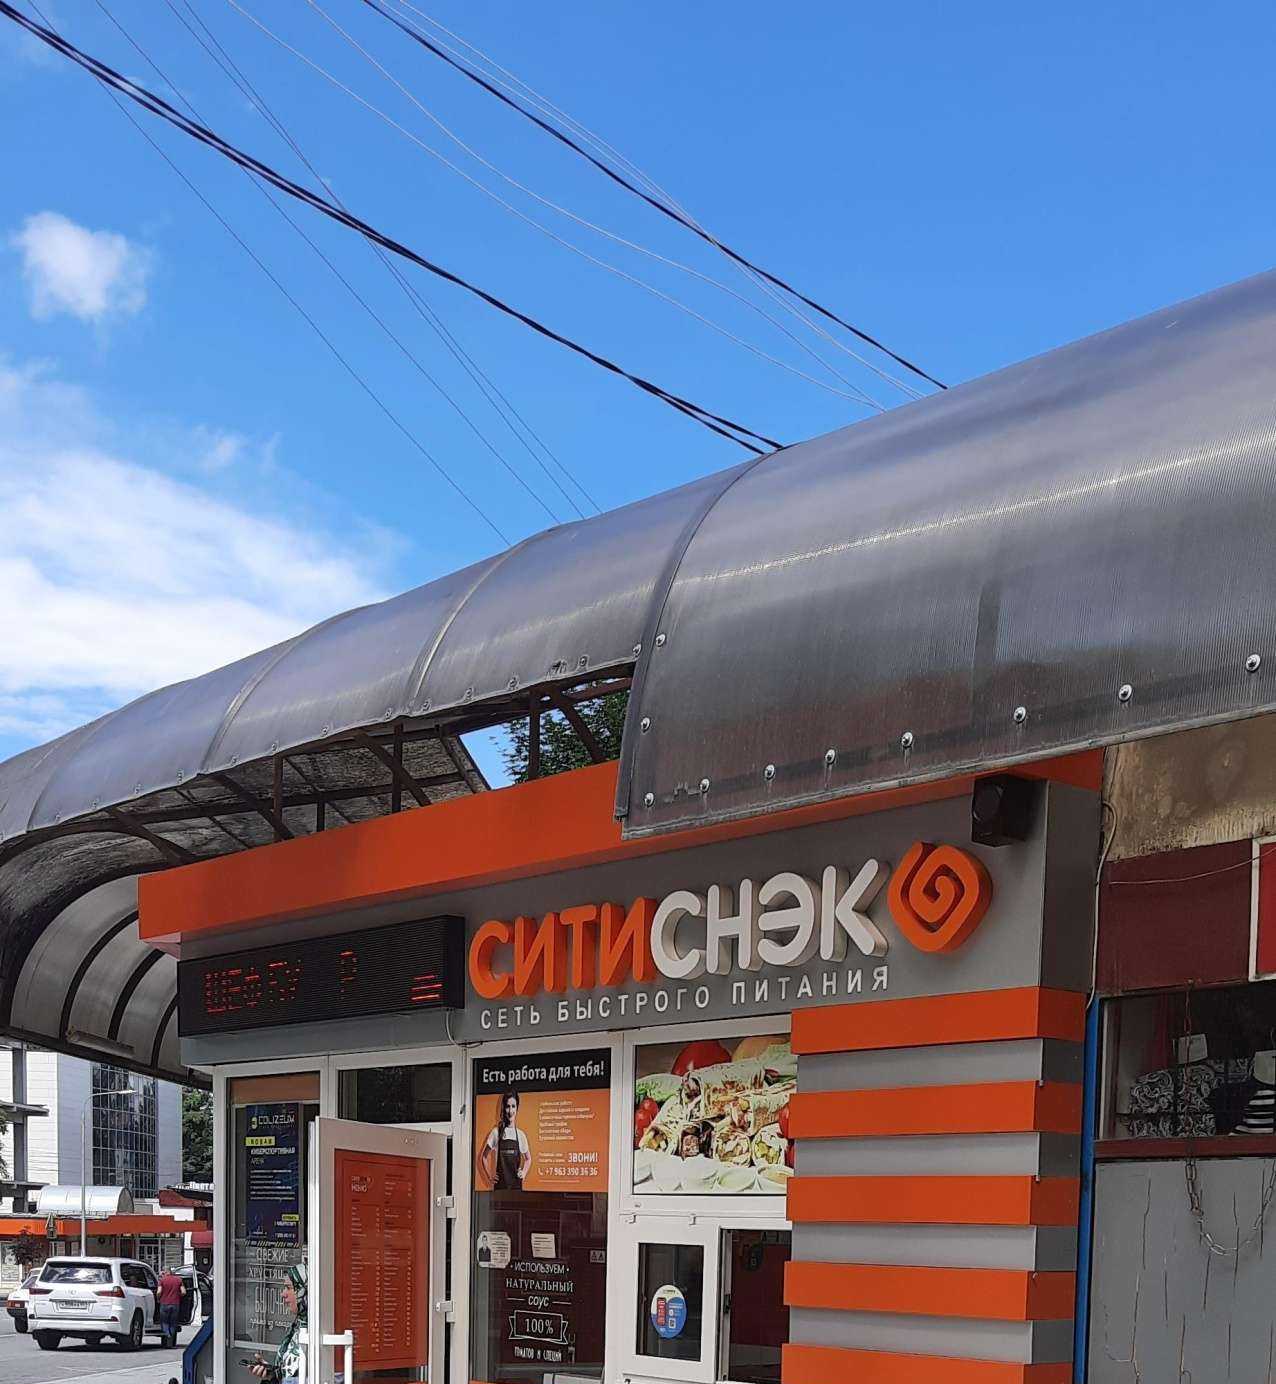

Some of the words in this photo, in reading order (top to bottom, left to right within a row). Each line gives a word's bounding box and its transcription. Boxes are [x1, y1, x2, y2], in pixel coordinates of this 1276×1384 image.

[469, 858, 891, 999] СИТИСНЭК
[481, 1004, 540, 1030] СЕТЬ
[558, 986, 710, 1023] БЫСТРОГО
[732, 965, 889, 1004] ПИТАНИЯ
[483, 1068, 506, 1083] Есть
[508, 1065, 547, 1085] работа
[548, 1065, 571, 1082] для
[573, 1060, 605, 1078] тебя!
[567, 1151, 598, 1163] ЗВОНИ!
[515, 1261, 565, 1274] ИСПОЛЬЗУЕМ
[506, 1278, 574, 1293] НАТУРАЛЬНЫЙ
[525, 1318, 554, 1334] 100%
